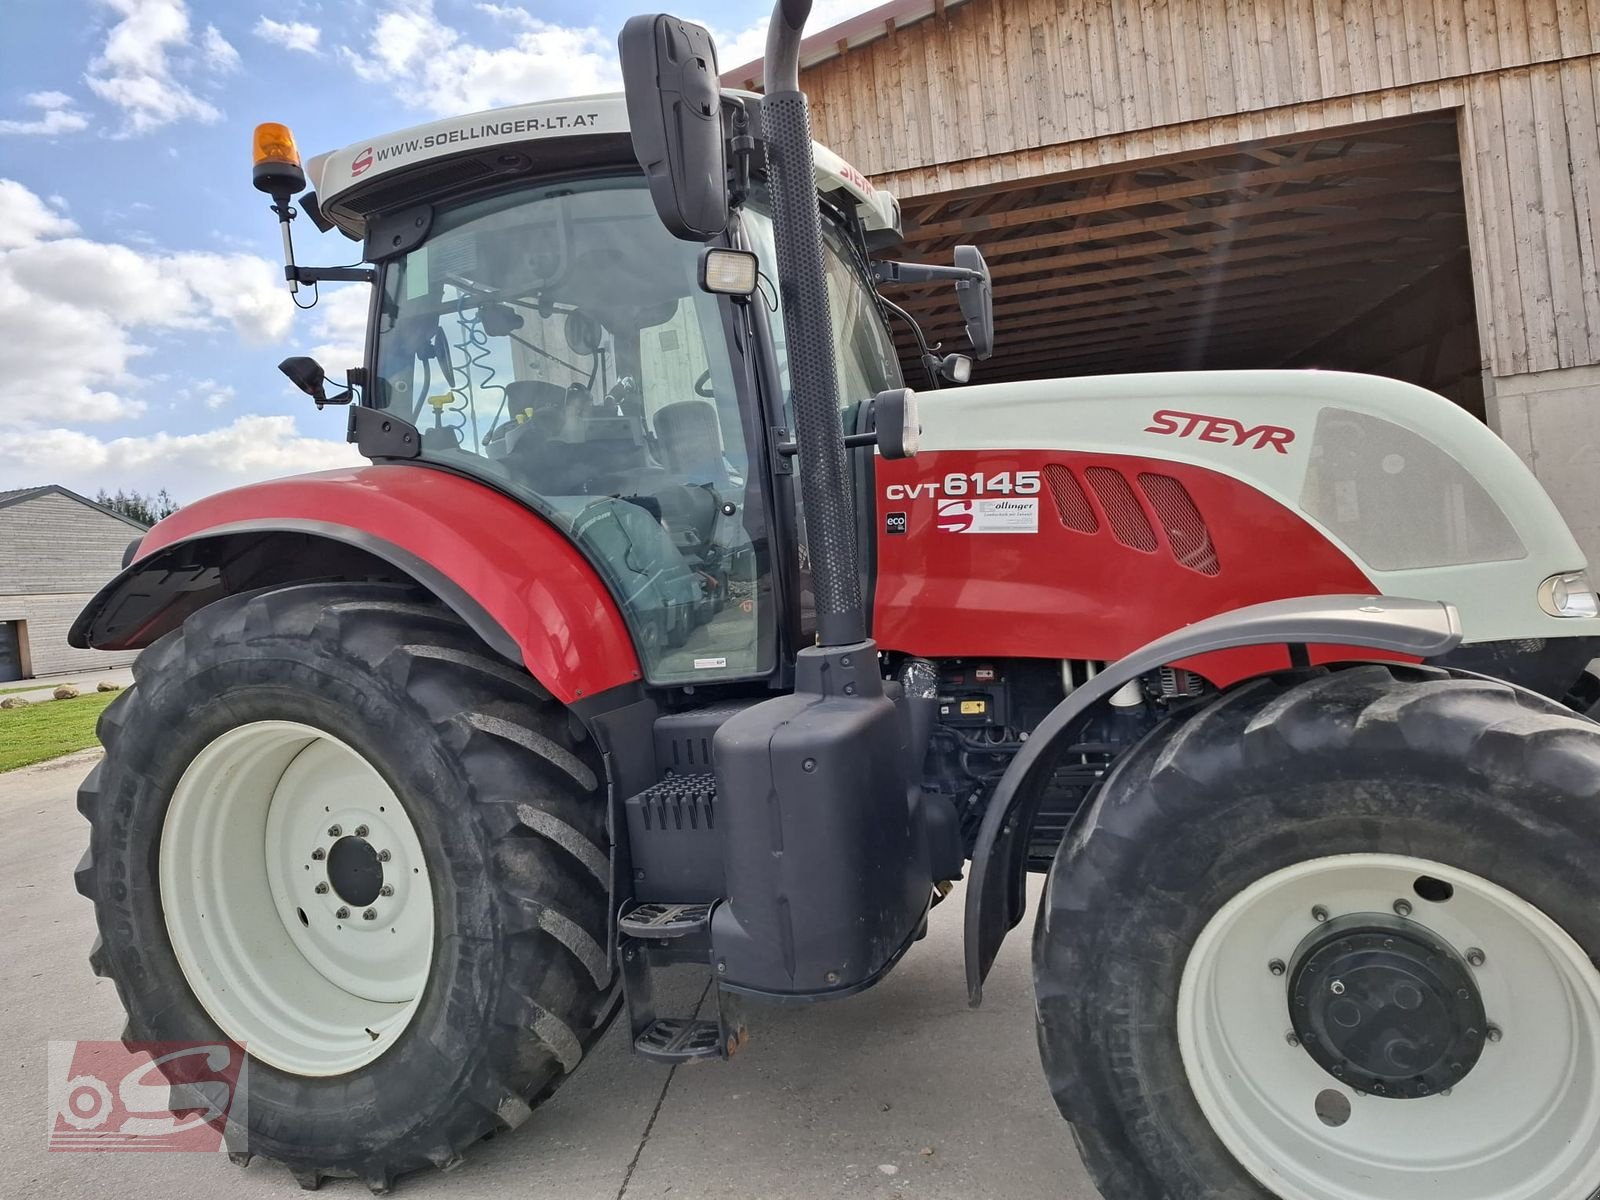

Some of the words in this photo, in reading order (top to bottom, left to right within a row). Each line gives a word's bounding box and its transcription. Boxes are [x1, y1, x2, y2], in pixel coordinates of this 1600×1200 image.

[377, 113, 599, 162] WWW.SOELLINGER-LT.AT
[1144, 409, 1296, 454] STEYR
[886, 483, 940, 500] CVT
[944, 471, 1041, 495] 6145
[887, 517, 905, 526] eco
